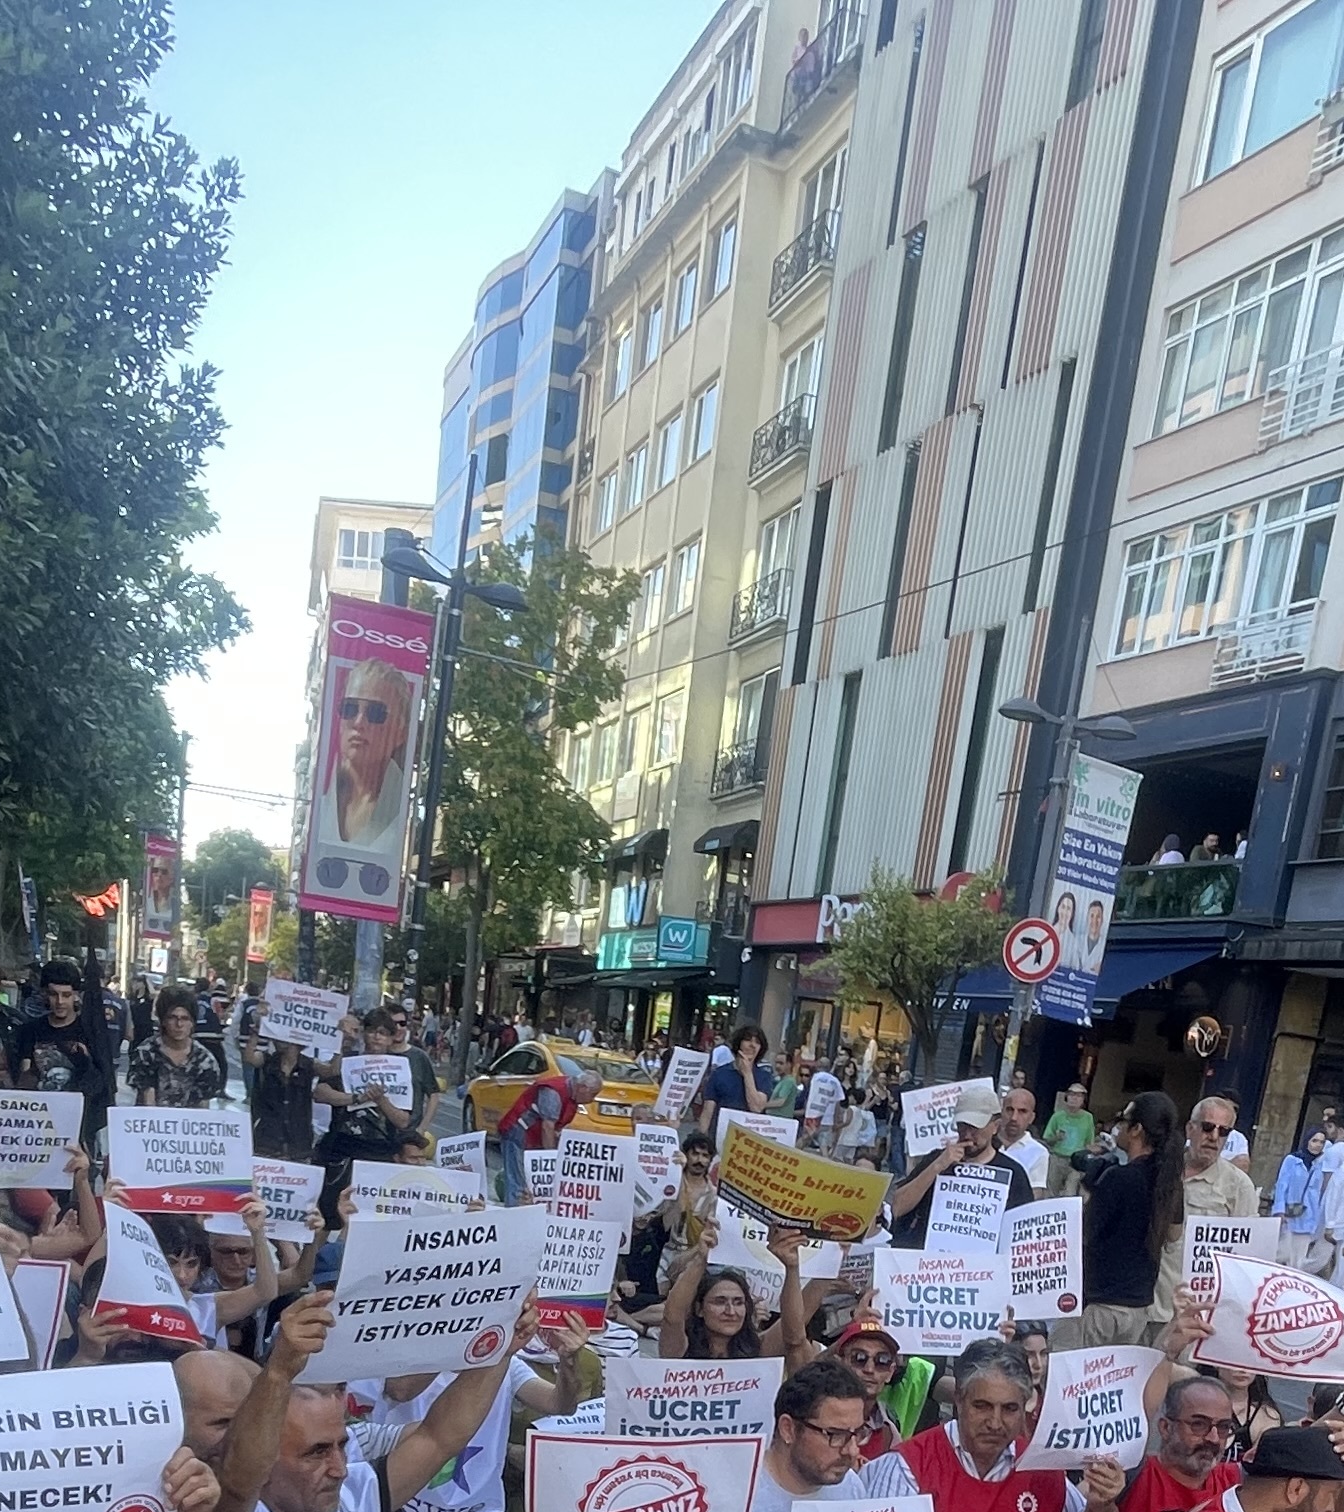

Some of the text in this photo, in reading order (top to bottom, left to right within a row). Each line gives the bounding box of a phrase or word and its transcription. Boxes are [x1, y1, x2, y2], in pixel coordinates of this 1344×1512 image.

[332, 620, 428, 655] Ossé
[1097, 796, 1131, 821] vitro
[1084, 838, 1095, 853] En
[269, 1013, 338, 1037] İSTİYORUZ
[124, 1119, 241, 1138] SEFALET ÜCRETİNE
[24, 1133, 71, 1147] ÜCRET
[142, 1137, 226, 1156] YOKSULLUĞA
[564, 1139, 617, 1161] SEFALET
[145, 1157, 224, 1175] AÇLIĞA SON!
[561, 1158, 624, 1183] ÜCRETİNİ
[356, 1184, 421, 1200] İŞÇİLERİN
[559, 1181, 602, 1201] KABUL
[952, 1212, 981, 1226] EMEK
[404, 1225, 498, 1252] İNSANCA
[587, 1230, 603, 1243] AÇ
[1012, 1224, 1067, 1243] ZAM ŞART!
[1194, 1224, 1251, 1244] BİZDEN
[577, 1243, 606, 1260] İŞSİZ
[1011, 1251, 1067, 1269] ZAM ŞART!
[384, 1257, 502, 1285] YAŞAMAYA
[918, 1258, 964, 1270] İNSANCA
[889, 1270, 995, 1286] YAŞAMAYA YETECEK
[1012, 1277, 1067, 1296] ZAM ŞART!
[337, 1284, 521, 1316] YETECEK ÜCRET
[907, 1280, 979, 1306] ÜCRET
[884, 1303, 1000, 1331] İSTİYORUZ
[354, 1316, 484, 1343] İSTİYORUZ!
[664, 1368, 724, 1383] İNSANCA
[626, 1377, 761, 1400] YAŞAMAYA YETECEK
[52, 1399, 171, 1429] BİRLİĞİ
[648, 1395, 741, 1421] ÜCRET
[1077, 1388, 1124, 1421] ÜCRET
[1044, 1415, 1143, 1450] İSTİYORUZ
